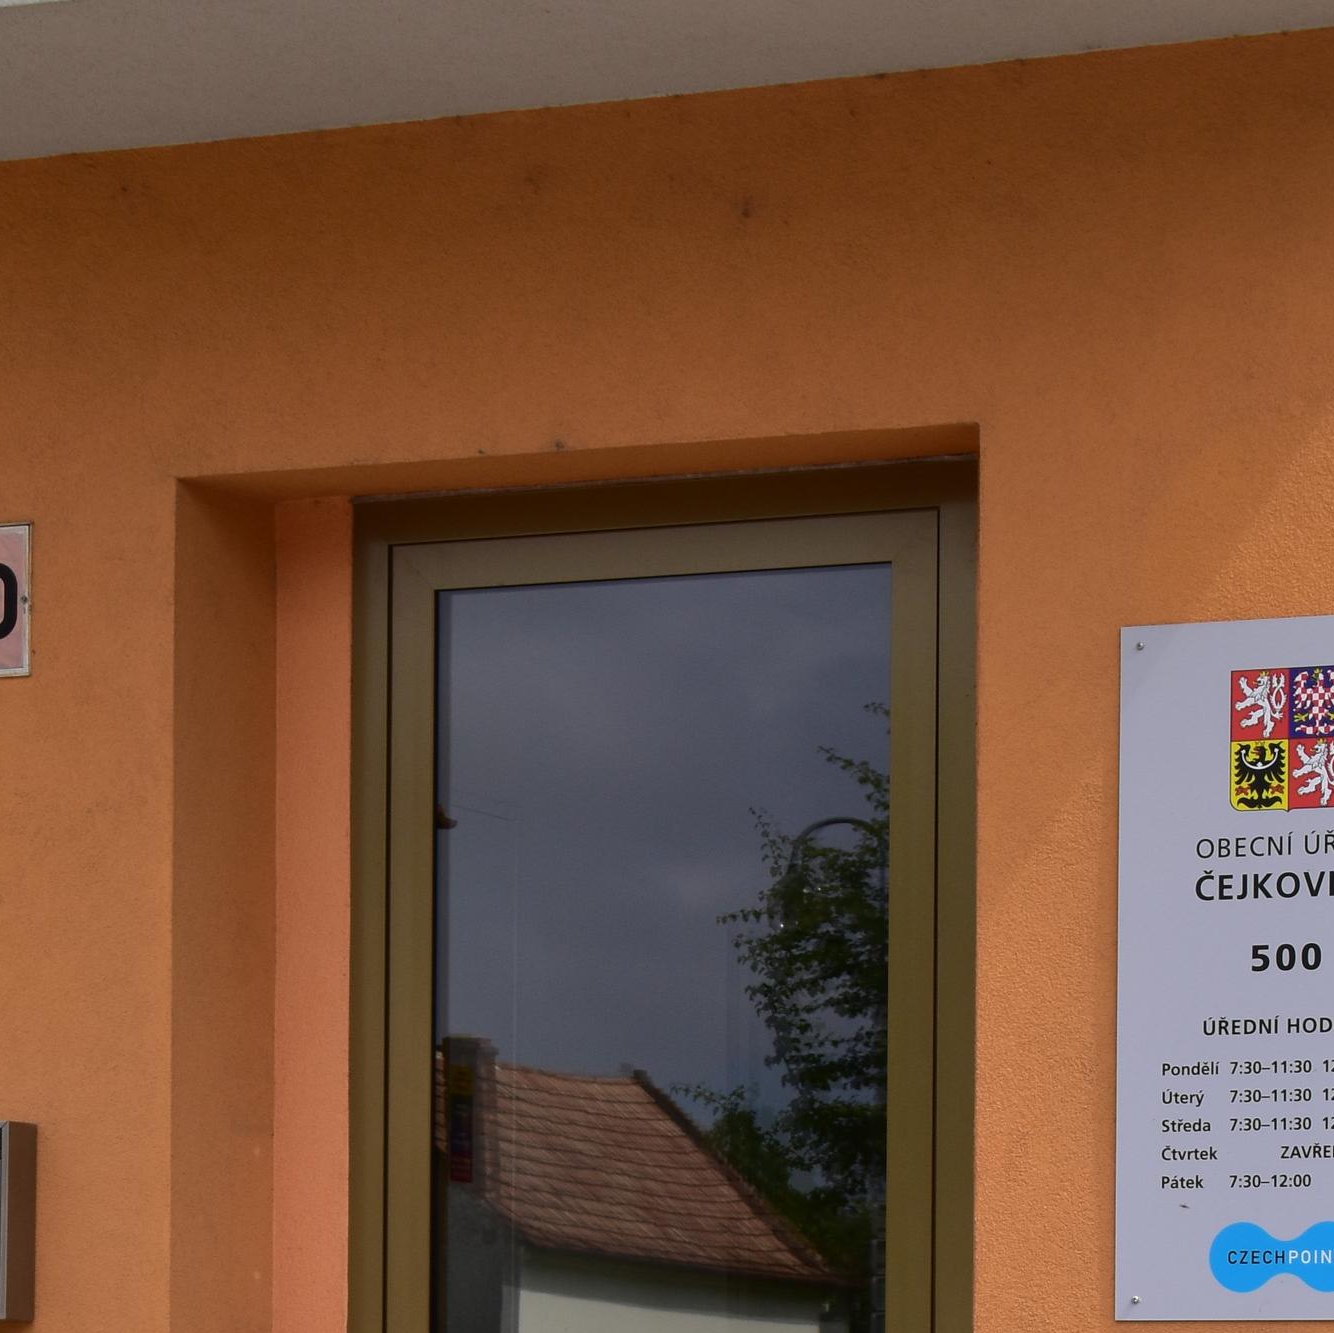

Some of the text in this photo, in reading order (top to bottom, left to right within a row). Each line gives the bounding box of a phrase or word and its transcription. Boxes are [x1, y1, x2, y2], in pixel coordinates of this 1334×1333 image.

[1197, 832, 1293, 858] OBECNÍ
[1252, 943, 1321, 972] 500
[1204, 1016, 1279, 1035] ÚŘEDNÍ
[1162, 1061, 1219, 1076] Pondělí
[1162, 1089, 1204, 1107] Úterý
[1162, 1118, 1210, 1132] Středa
[1162, 1146, 1217, 1160] Čtvrtek
[1162, 1175, 1203, 1189] Pátek
